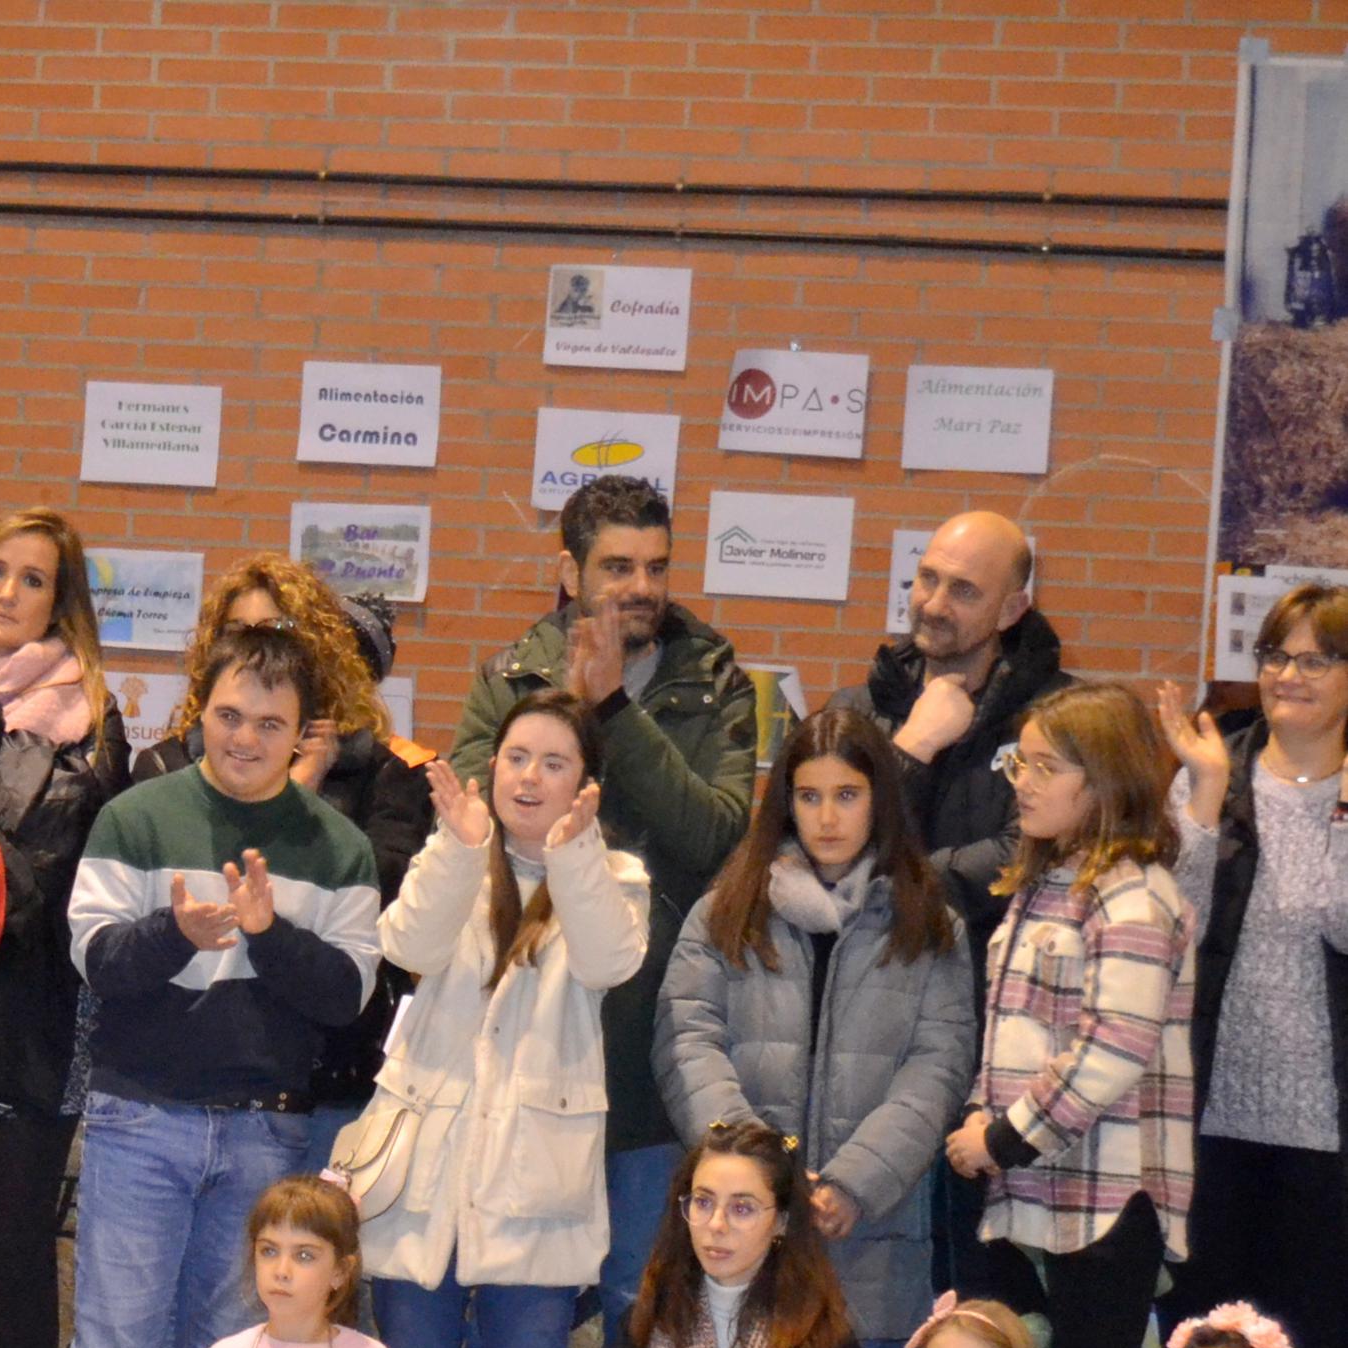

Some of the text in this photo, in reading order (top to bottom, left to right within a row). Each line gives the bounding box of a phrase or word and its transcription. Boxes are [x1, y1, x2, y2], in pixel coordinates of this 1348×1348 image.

[594, 343, 608, 353] de
[318, 387, 425, 405] Alimentación
[918, 379, 1044, 398] Alimentación
[318, 422, 418, 446] Carmina
[933, 417, 1022, 434] Mari Paz
[344, 523, 379, 542] Bar
[725, 545, 826, 562] Javier Molinero
[341, 561, 405, 578] Puente
[127, 585, 141, 597] de
